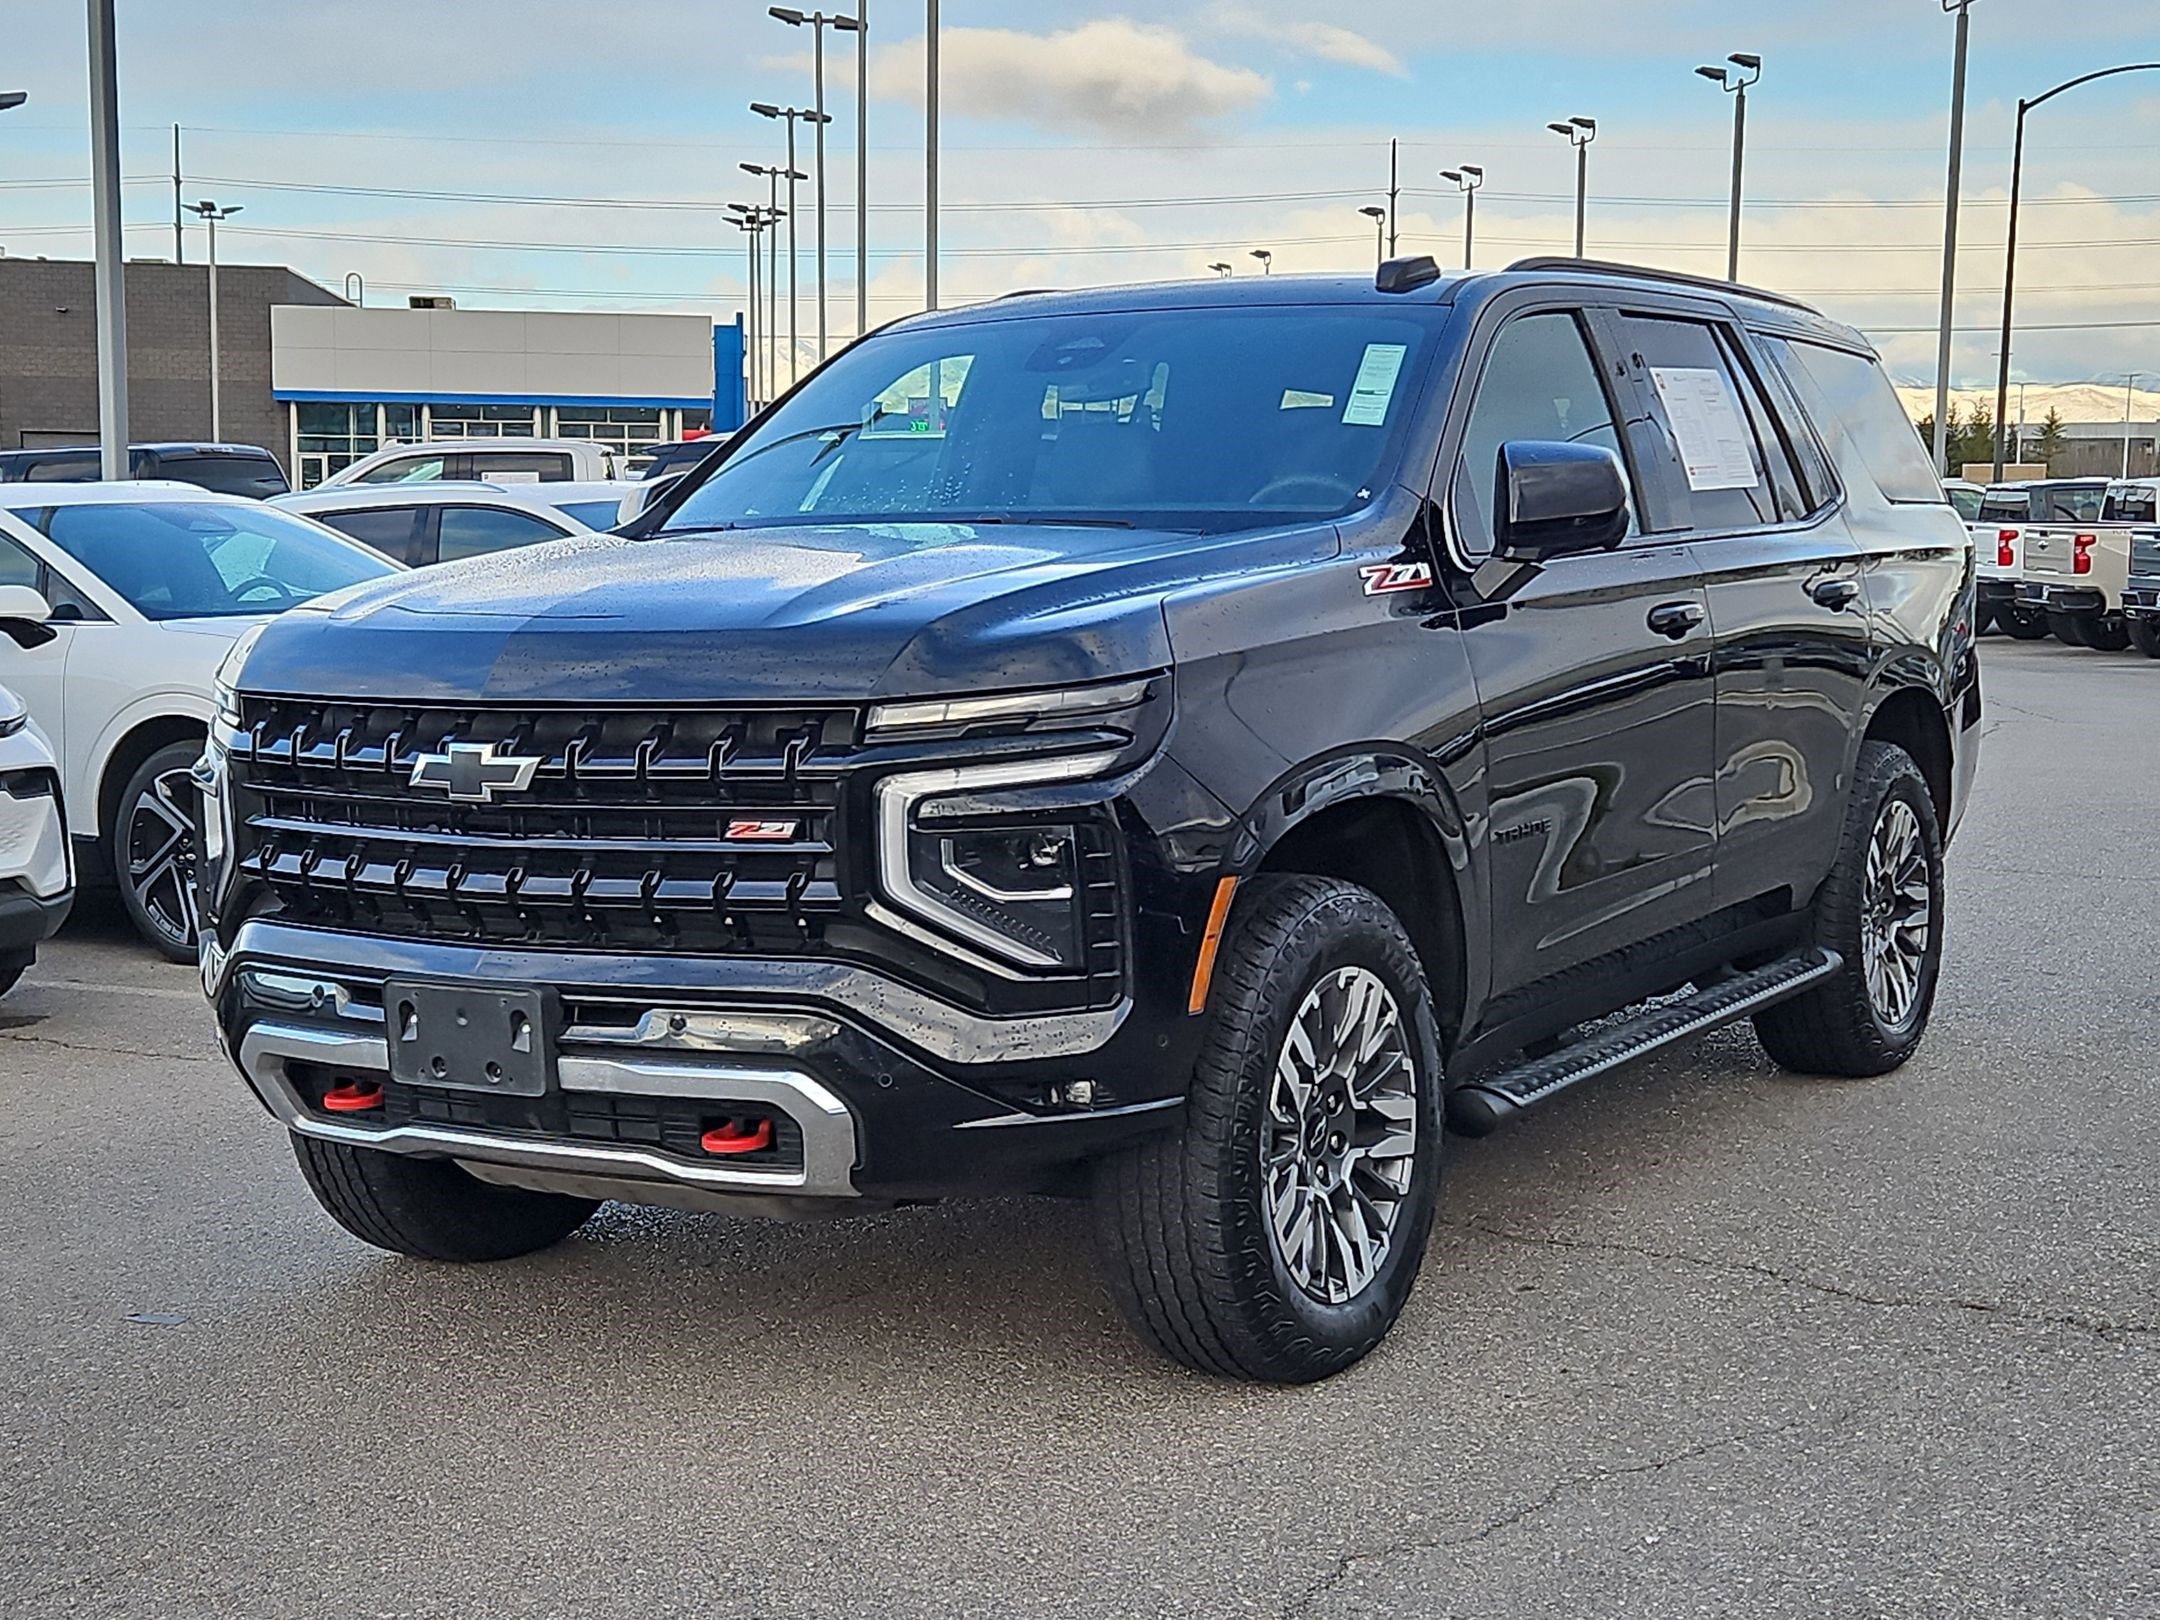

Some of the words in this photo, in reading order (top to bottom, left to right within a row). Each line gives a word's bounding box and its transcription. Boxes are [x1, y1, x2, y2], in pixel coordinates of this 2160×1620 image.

[1358, 561, 1434, 596] Z71
[724, 821, 797, 839] Z71
[1494, 816, 1552, 844] TAHOE
